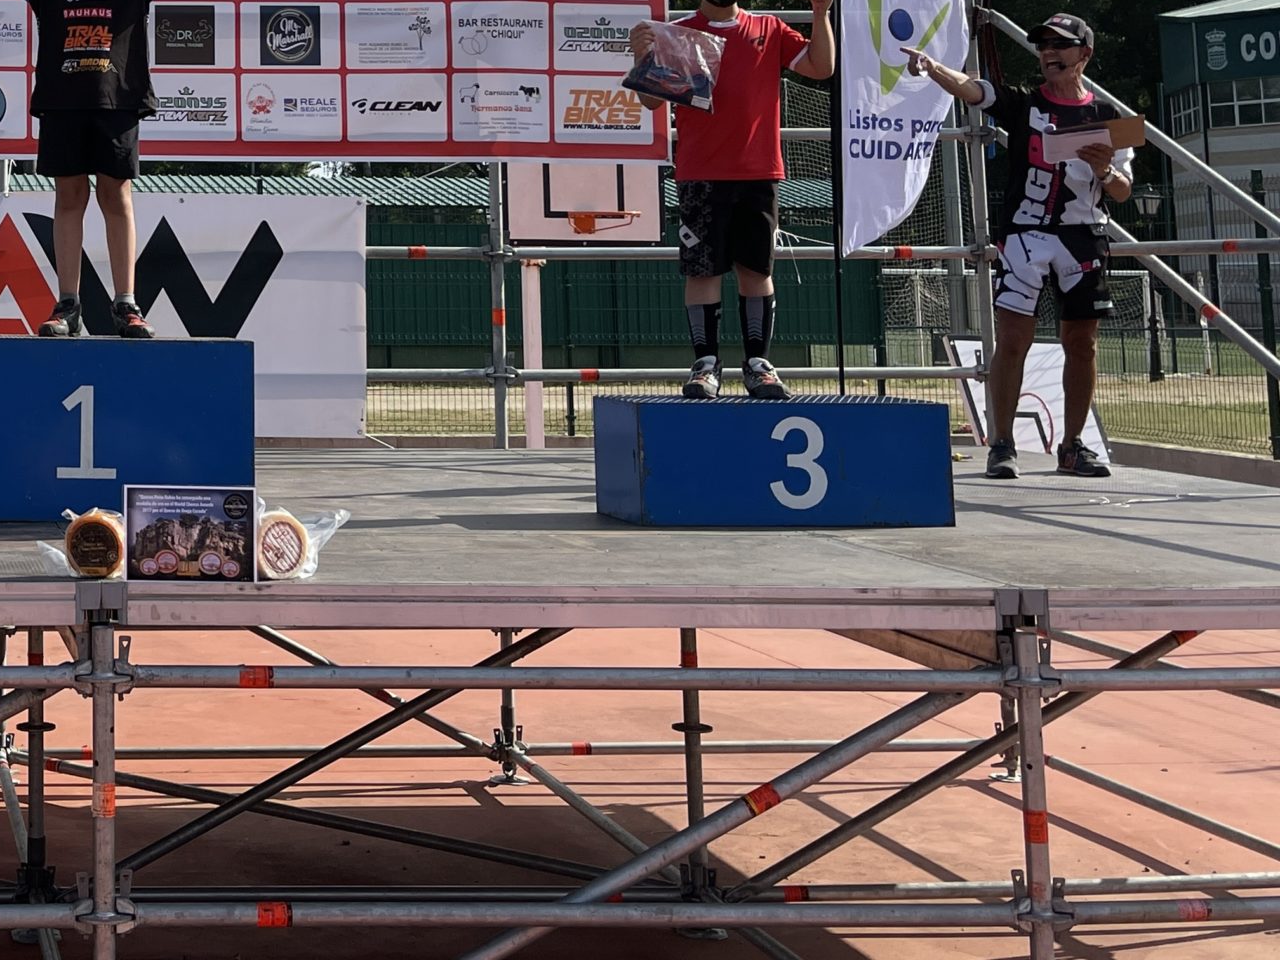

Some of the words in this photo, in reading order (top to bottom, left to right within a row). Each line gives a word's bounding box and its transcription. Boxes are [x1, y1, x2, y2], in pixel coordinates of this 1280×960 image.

[63, 9, 112, 18] BAUHAUS
[458, 19, 477, 28] BAR
[480, 18, 544, 29] RESTAURANTE
[67, 25, 112, 37] TRIAL
[176, 30, 192, 40] DR
[267, 25, 314, 49] Marshall
[487, 30, 525, 39] "CHIQUI"
[64, 37, 112, 48] BIKES
[1240, 31, 1280, 62] CO
[300, 98, 337, 106] REALE
[569, 90, 641, 107] TRIAL
[369, 101, 442, 112] CLEAN
[564, 107, 641, 124] BIKES
[850, 109, 903, 132] Listos
[850, 139, 932, 160] CUIDART
[56, 385, 117, 479] 1
[769, 416, 828, 510] 3
